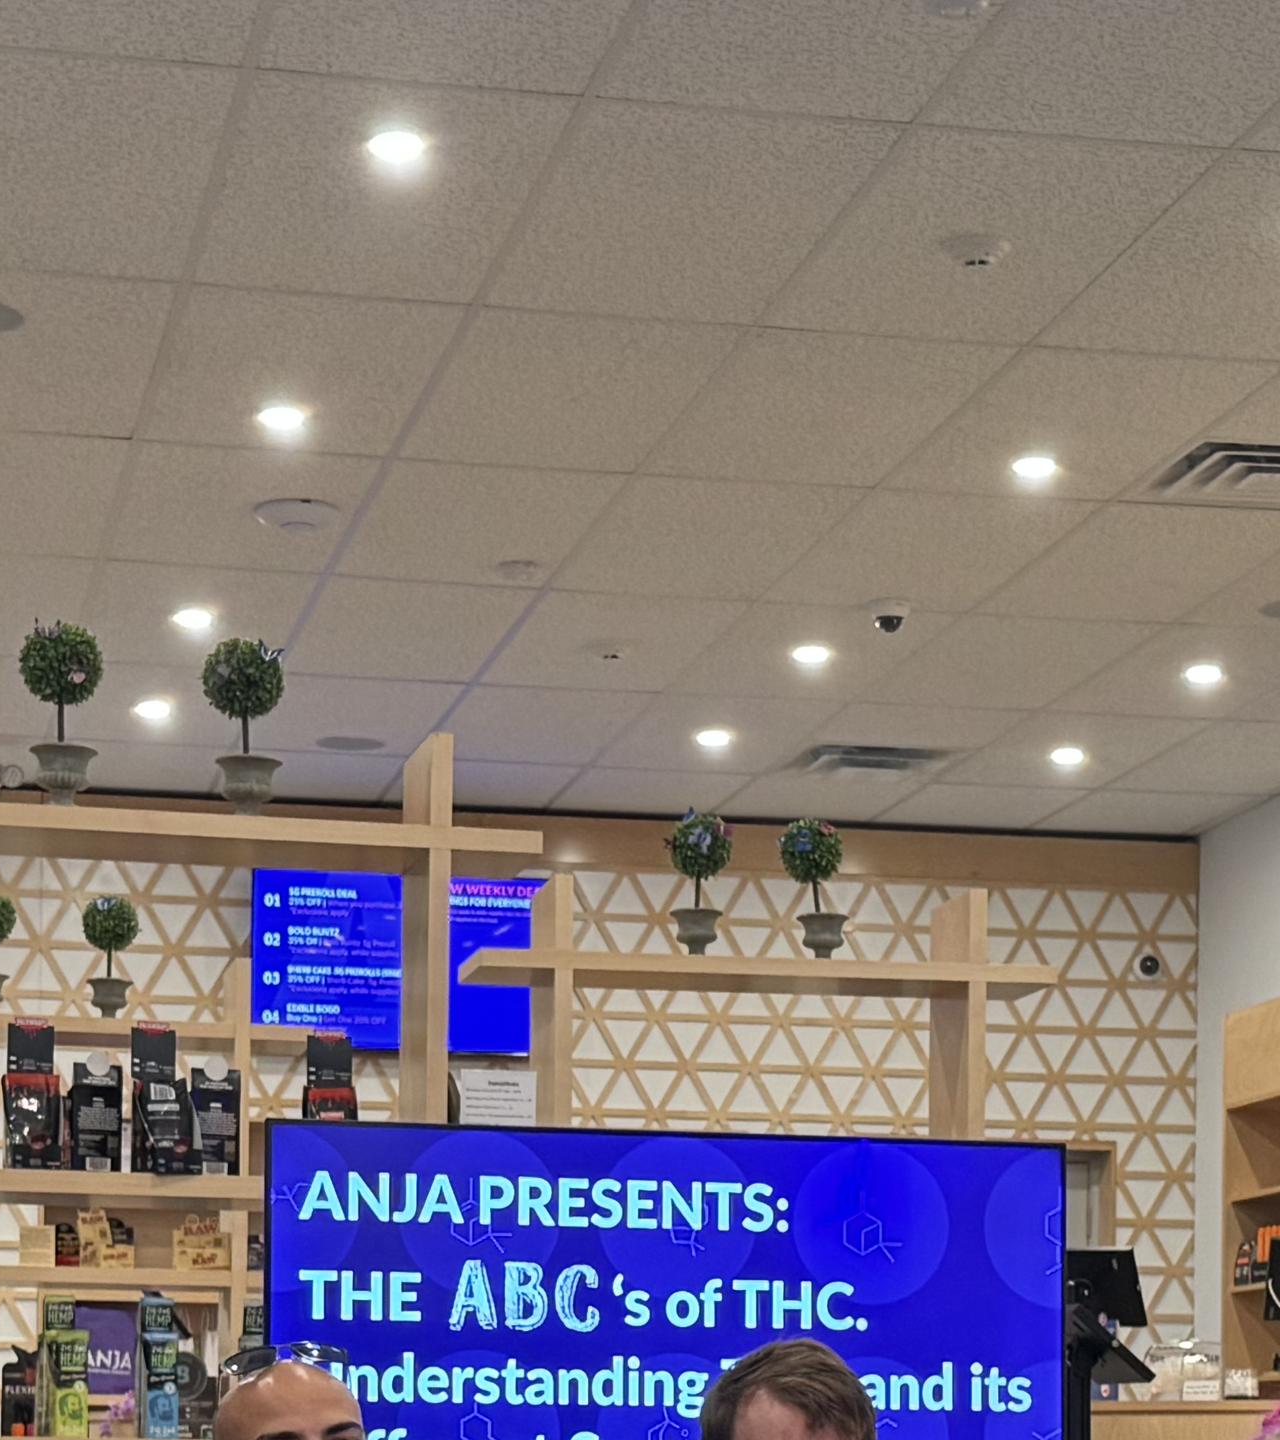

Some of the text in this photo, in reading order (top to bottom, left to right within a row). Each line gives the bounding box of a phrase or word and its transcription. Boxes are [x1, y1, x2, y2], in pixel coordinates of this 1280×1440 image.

[465, 884, 516, 897] WEEKLY
[517, 886, 539, 898] DEA
[263, 892, 281, 908] 01
[263, 931, 281, 947] 02
[262, 970, 281, 986] 03
[261, 1009, 280, 1025] 04
[298, 1170, 790, 1233] ANJA PRESENTS:
[183, 1222, 218, 1237] RAW
[298, 1268, 422, 1322] THE
[448, 1259, 601, 1333] ABC
[665, 1278, 723, 1328] of
[732, 1279, 869, 1332] THC.
[47, 1311, 74, 1324] HEMP
[145, 1313, 171, 1327] HEMP
[88, 1349, 132, 1370] ANJA
[857, 1361, 954, 1412] and
[969, 1361, 1033, 1413] its
